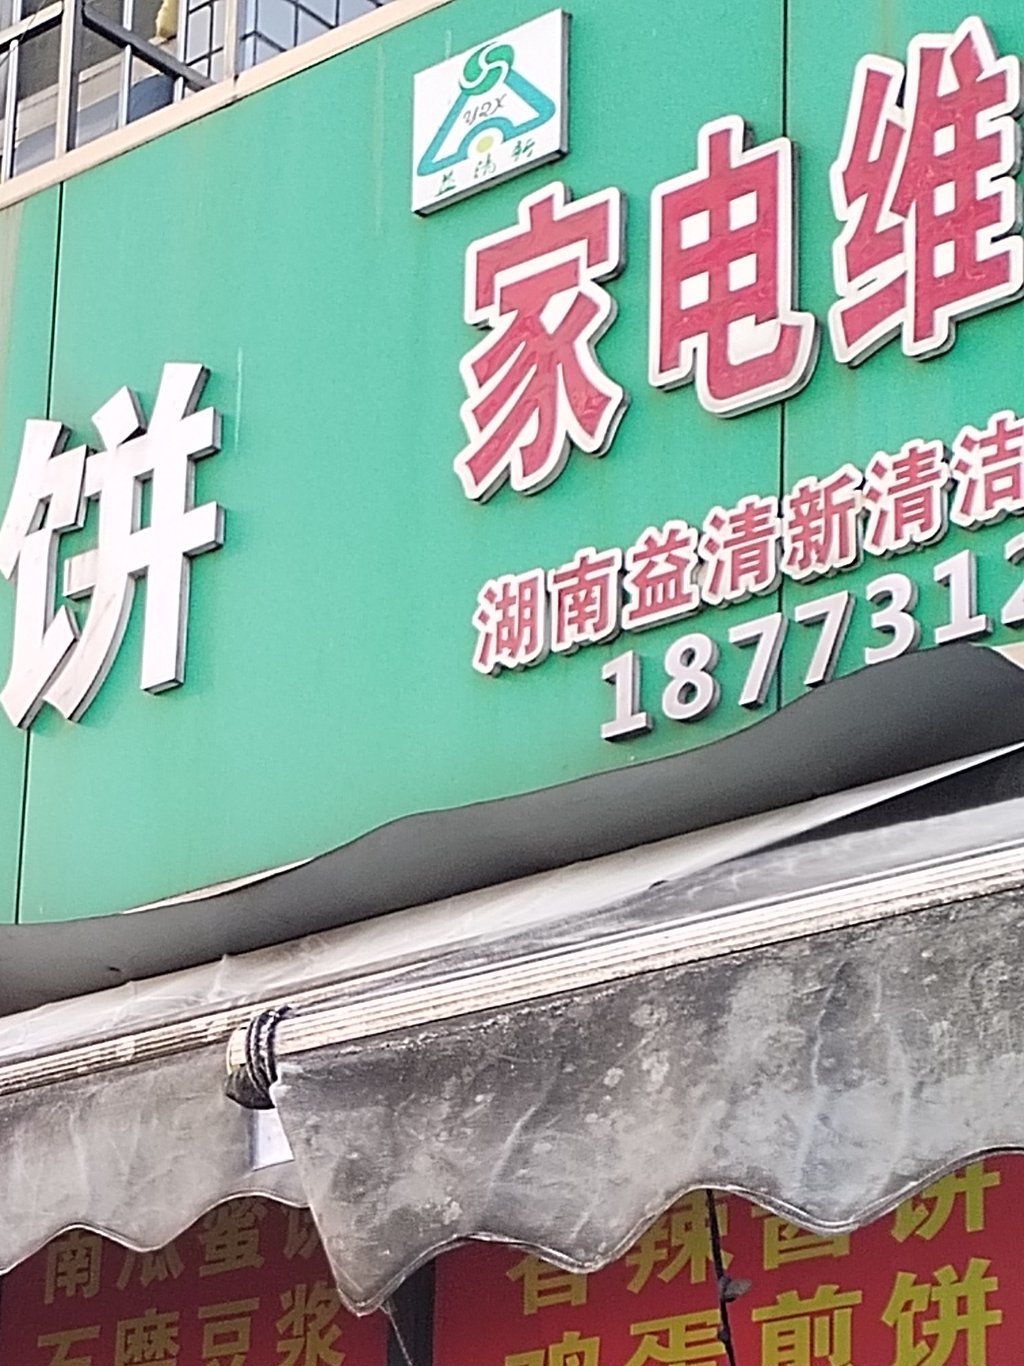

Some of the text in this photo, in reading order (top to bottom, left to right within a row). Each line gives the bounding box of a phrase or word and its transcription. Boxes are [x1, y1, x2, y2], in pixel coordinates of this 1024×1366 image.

[454, 16, 1024, 503] 家电维
[471, 410, 1024, 675] 湖南益清新清洁
